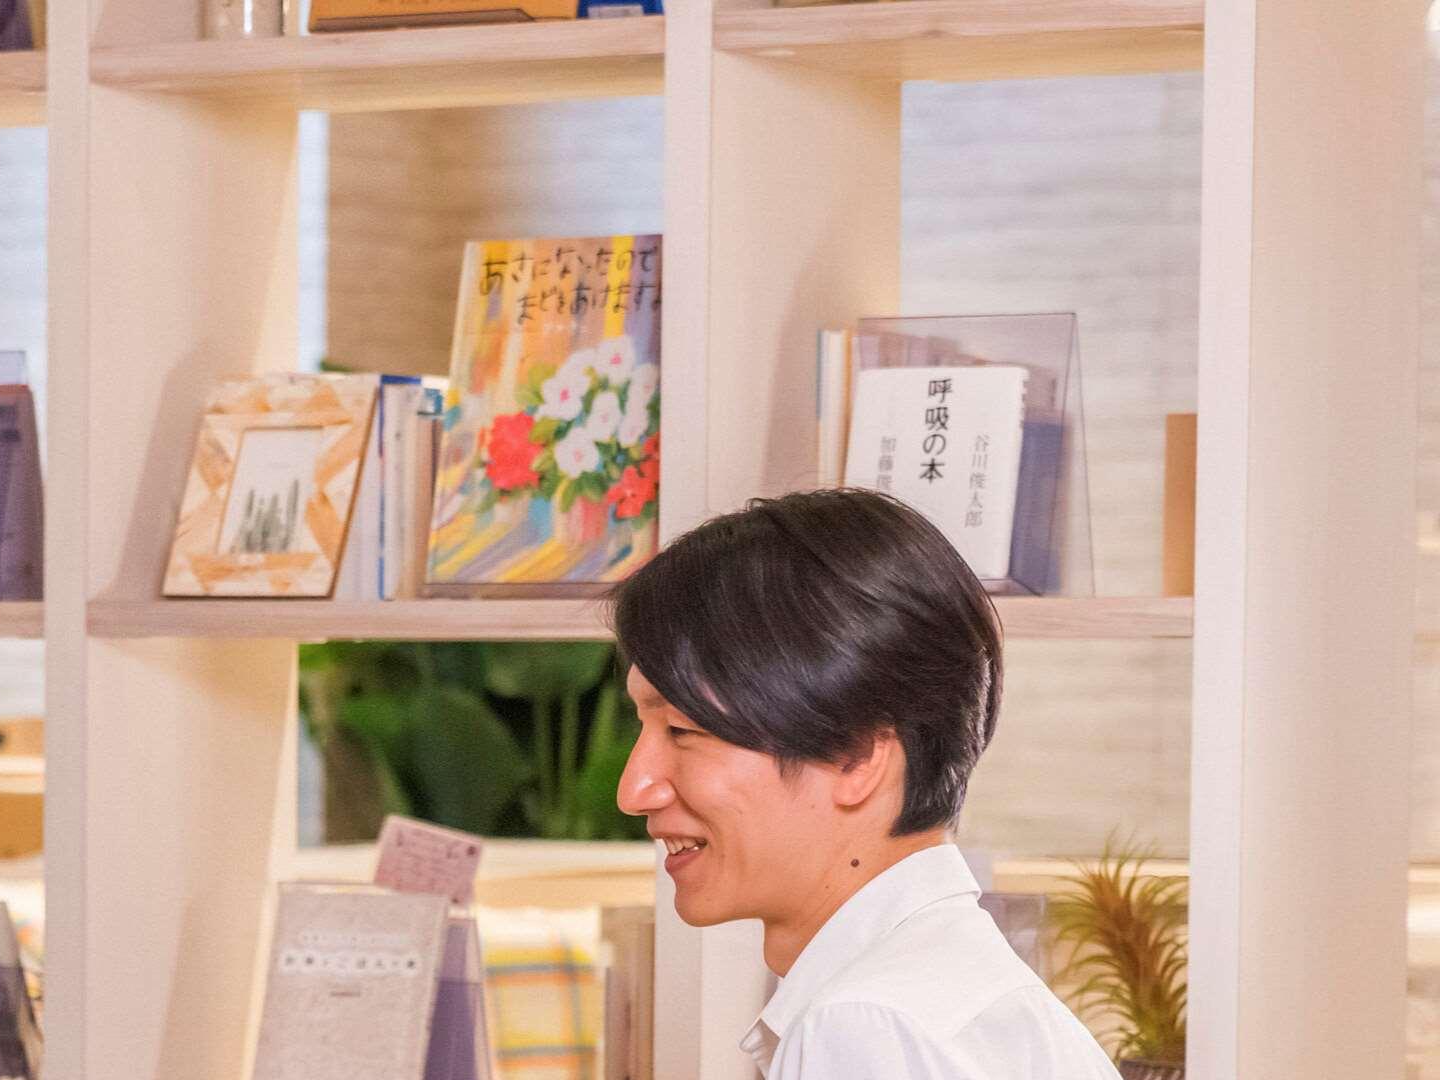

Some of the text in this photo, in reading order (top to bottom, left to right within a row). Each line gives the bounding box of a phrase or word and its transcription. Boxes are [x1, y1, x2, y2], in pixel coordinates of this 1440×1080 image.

[480, 246, 659, 296] あさになったので
[919, 377, 953, 485] 呼吸の本
[964, 433, 992, 529] 谷川俊太郎
